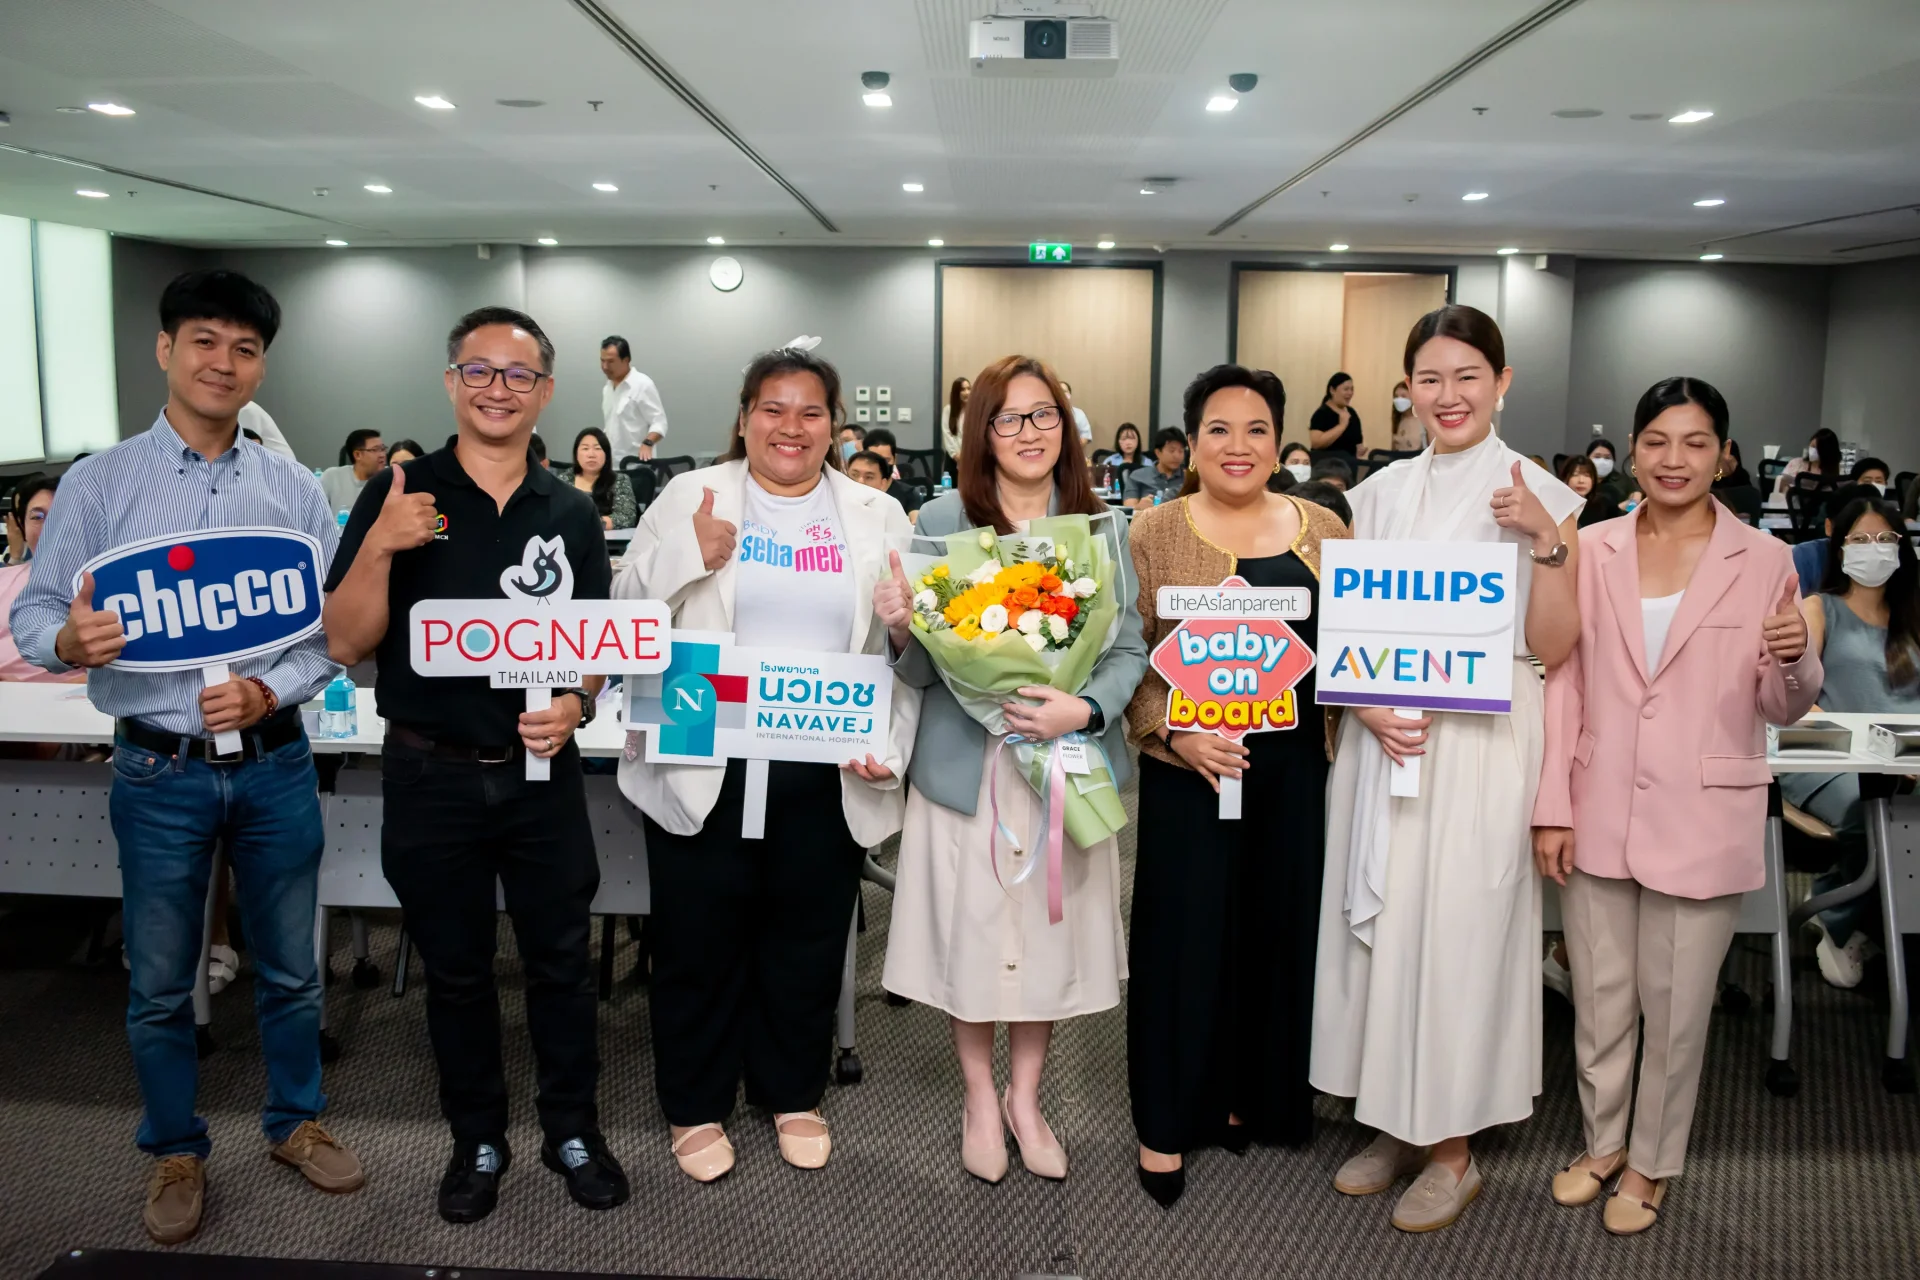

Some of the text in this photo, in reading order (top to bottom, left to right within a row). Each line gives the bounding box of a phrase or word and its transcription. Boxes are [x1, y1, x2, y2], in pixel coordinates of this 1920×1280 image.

[743, 519, 778, 538] Baby
[1333, 567, 1505, 604] PHILIPS
[1170, 591, 1298, 614] theAsianparent
[421, 618, 660, 662] POGNAE
[1178, 624, 1290, 673] baby
[498, 670, 578, 684] THAILAND
[760, 661, 820, 675] โรงพยาบาล
[1330, 645, 1487, 685] AVENT
[759, 676, 876, 707] นวเวช
[1208, 667, 1259, 696] on
[672, 687, 706, 712] N
[1168, 689, 1296, 730] board
[757, 711, 873, 733] NAVAVEJ
[756, 732, 871, 745] INTERNATIONAL HOSPITAL
